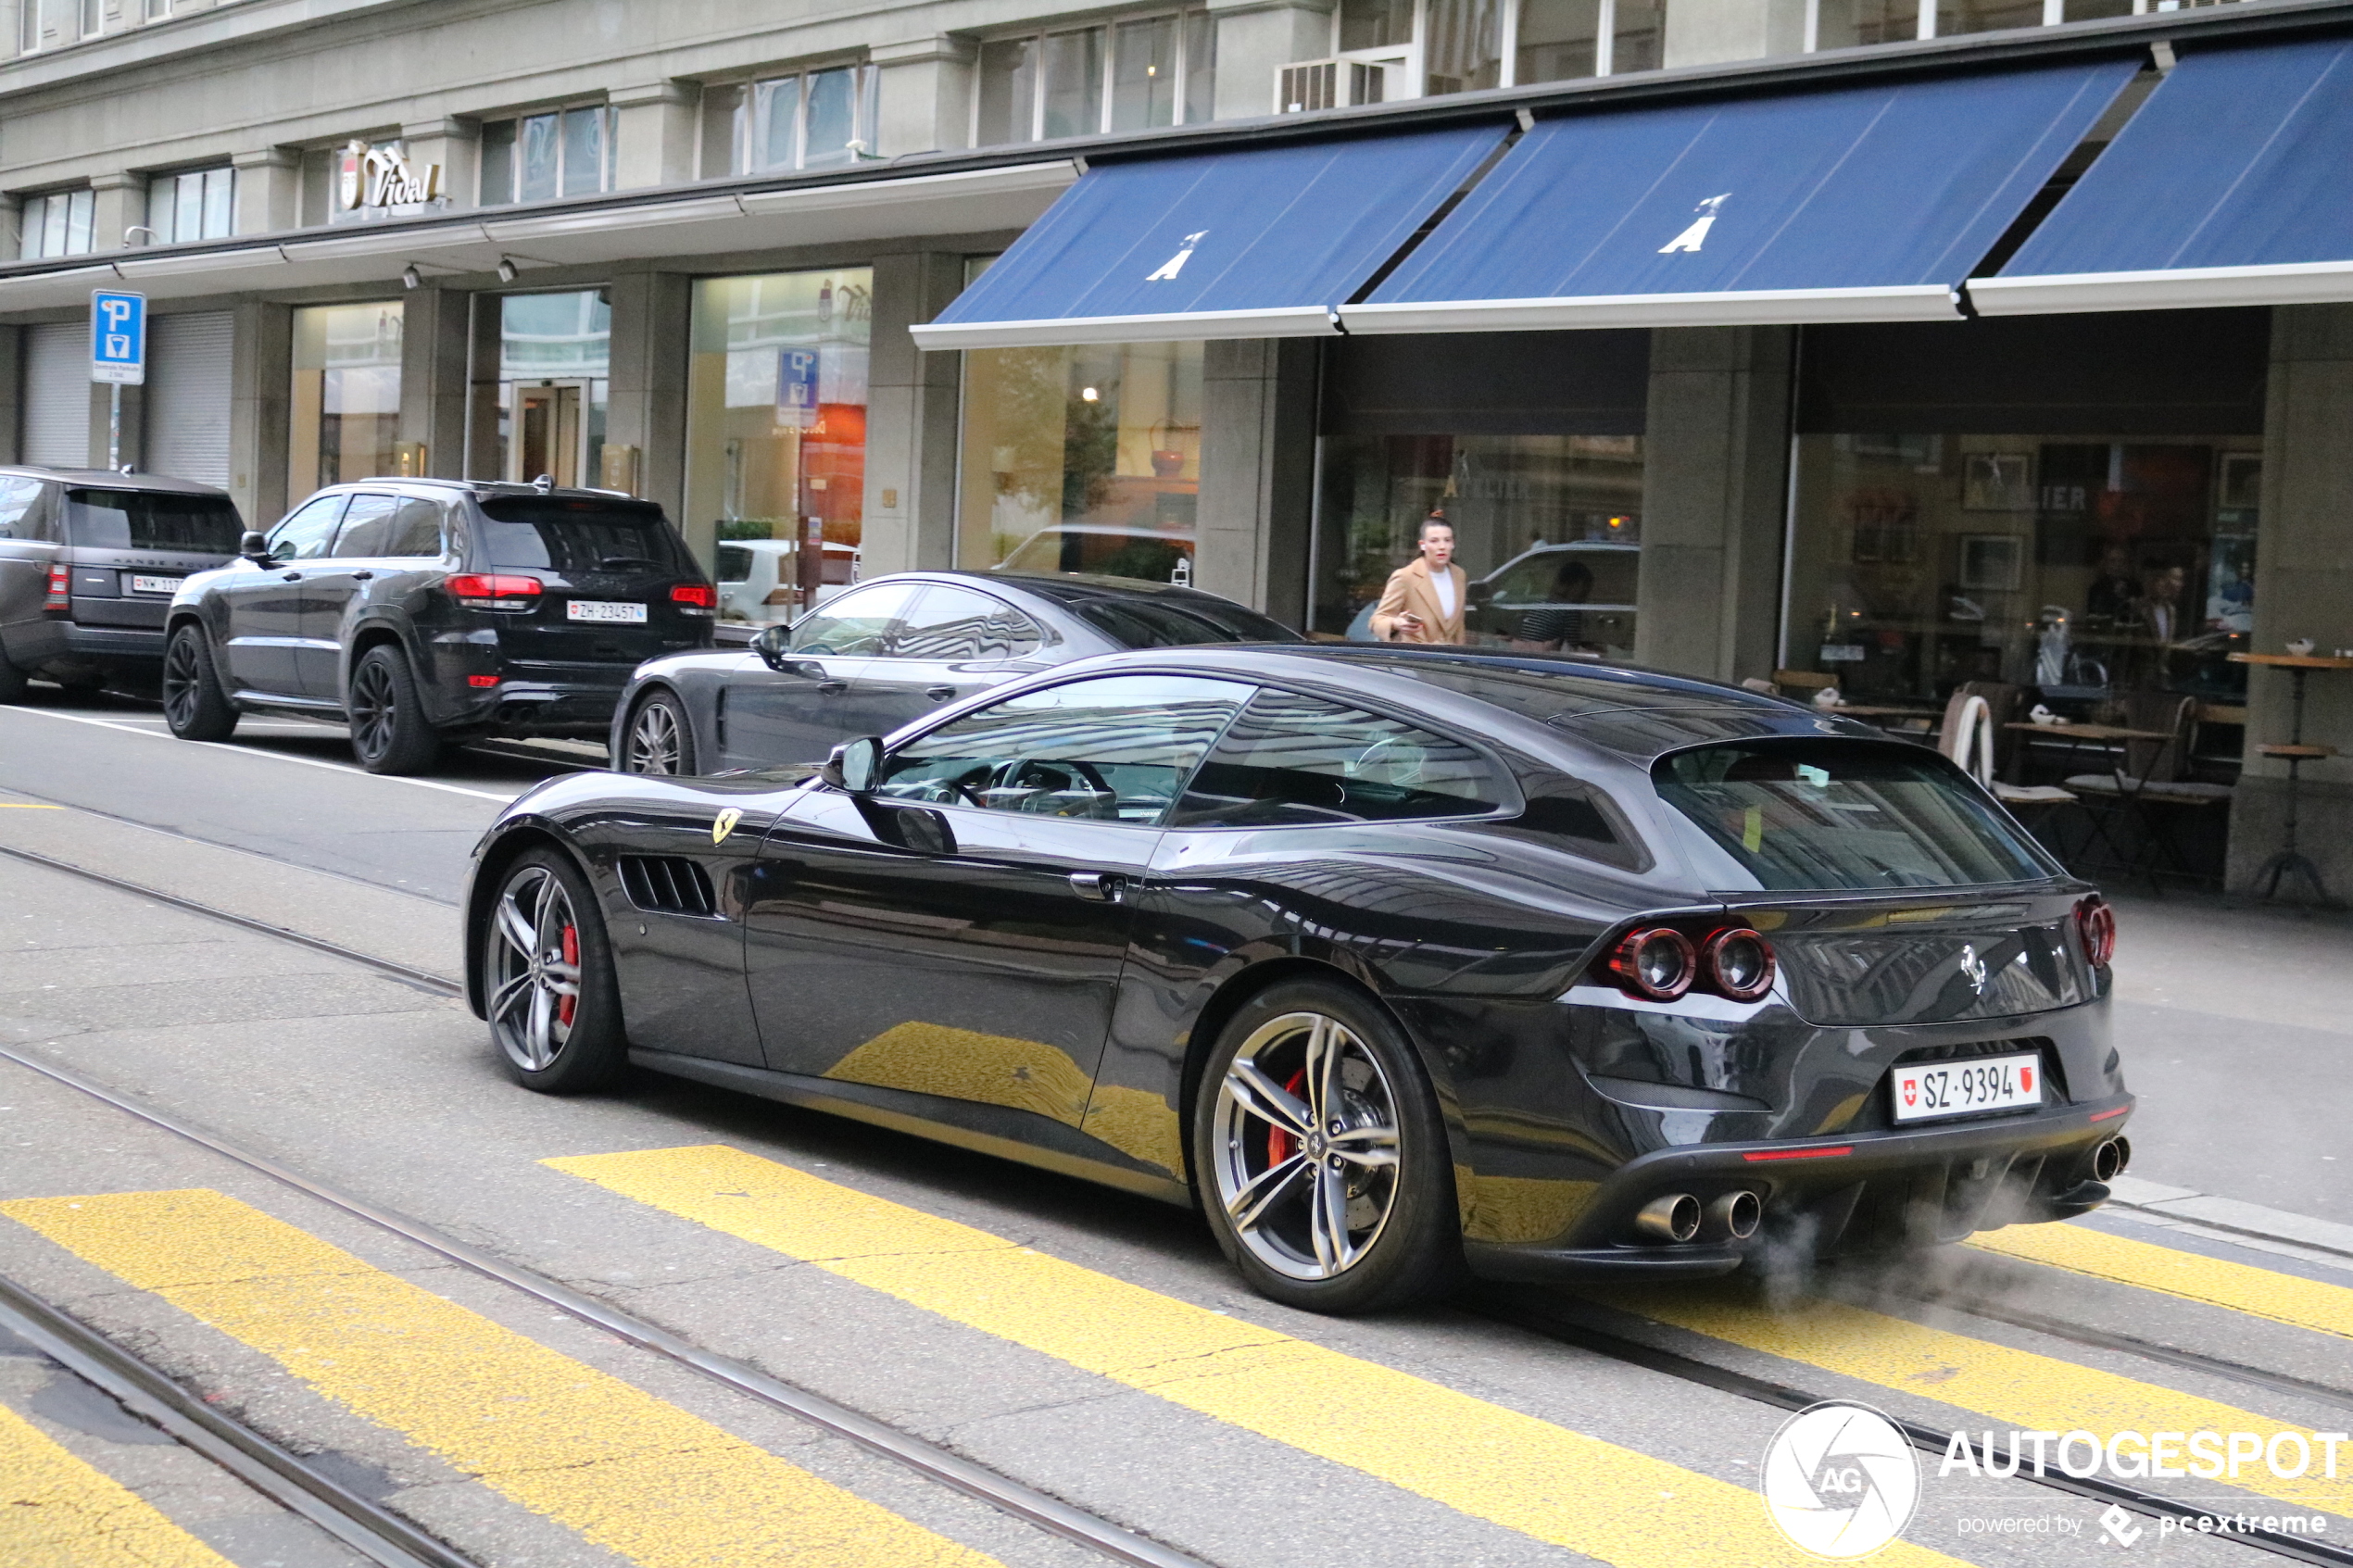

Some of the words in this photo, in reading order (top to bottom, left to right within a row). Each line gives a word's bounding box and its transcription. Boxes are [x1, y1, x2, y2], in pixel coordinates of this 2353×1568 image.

[363, 145, 436, 207] Vidal
[108, 300, 131, 332] P
[114, 558, 166, 567] RANGE
